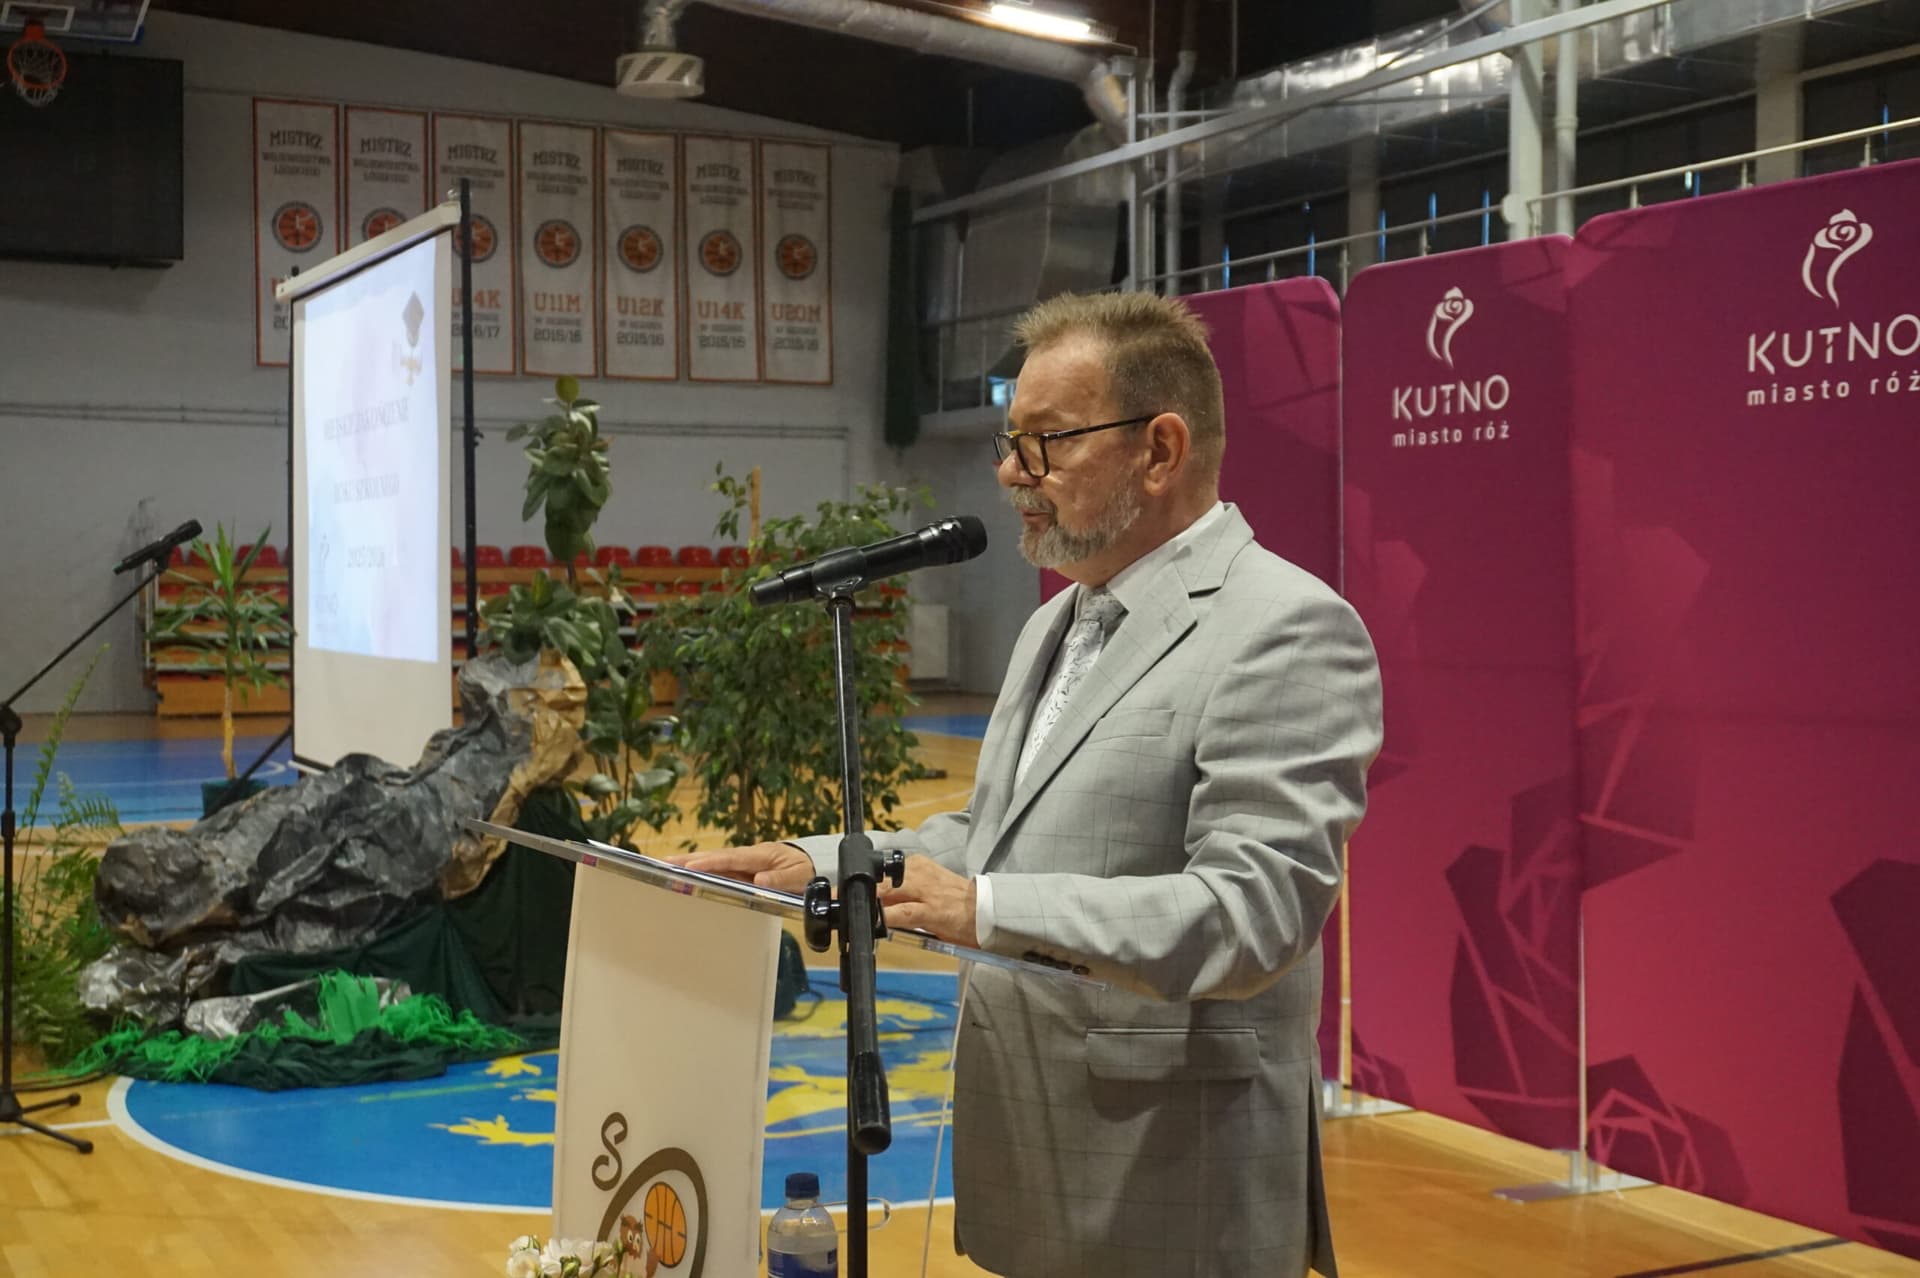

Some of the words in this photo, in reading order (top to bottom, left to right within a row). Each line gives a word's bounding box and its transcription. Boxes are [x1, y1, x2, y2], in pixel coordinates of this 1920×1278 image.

[269, 130, 323, 150] MISTRZ
[360, 137, 412, 157] MISTRZ
[448, 143, 497, 164] MISTRZ
[532, 150, 581, 170] MISTRZ
[616, 158, 664, 176] MISTRZ
[696, 164, 741, 181] MISTRZ
[451, 288, 502, 309] U4K
[534, 292, 581, 313] U11M
[616, 295, 665, 317] U12K
[698, 300, 745, 321] U14K
[771, 303, 821, 323] U20M
[533, 328, 583, 344] 2015/16
[1746, 314, 1920, 374] KUTNO
[1393, 374, 1510, 421] KUTNO
[1747, 379, 1850, 406] miasto
[1870, 370, 1920, 395] róż
[1394, 427, 1462, 447] miasto
[1474, 421, 1510, 440] róż
